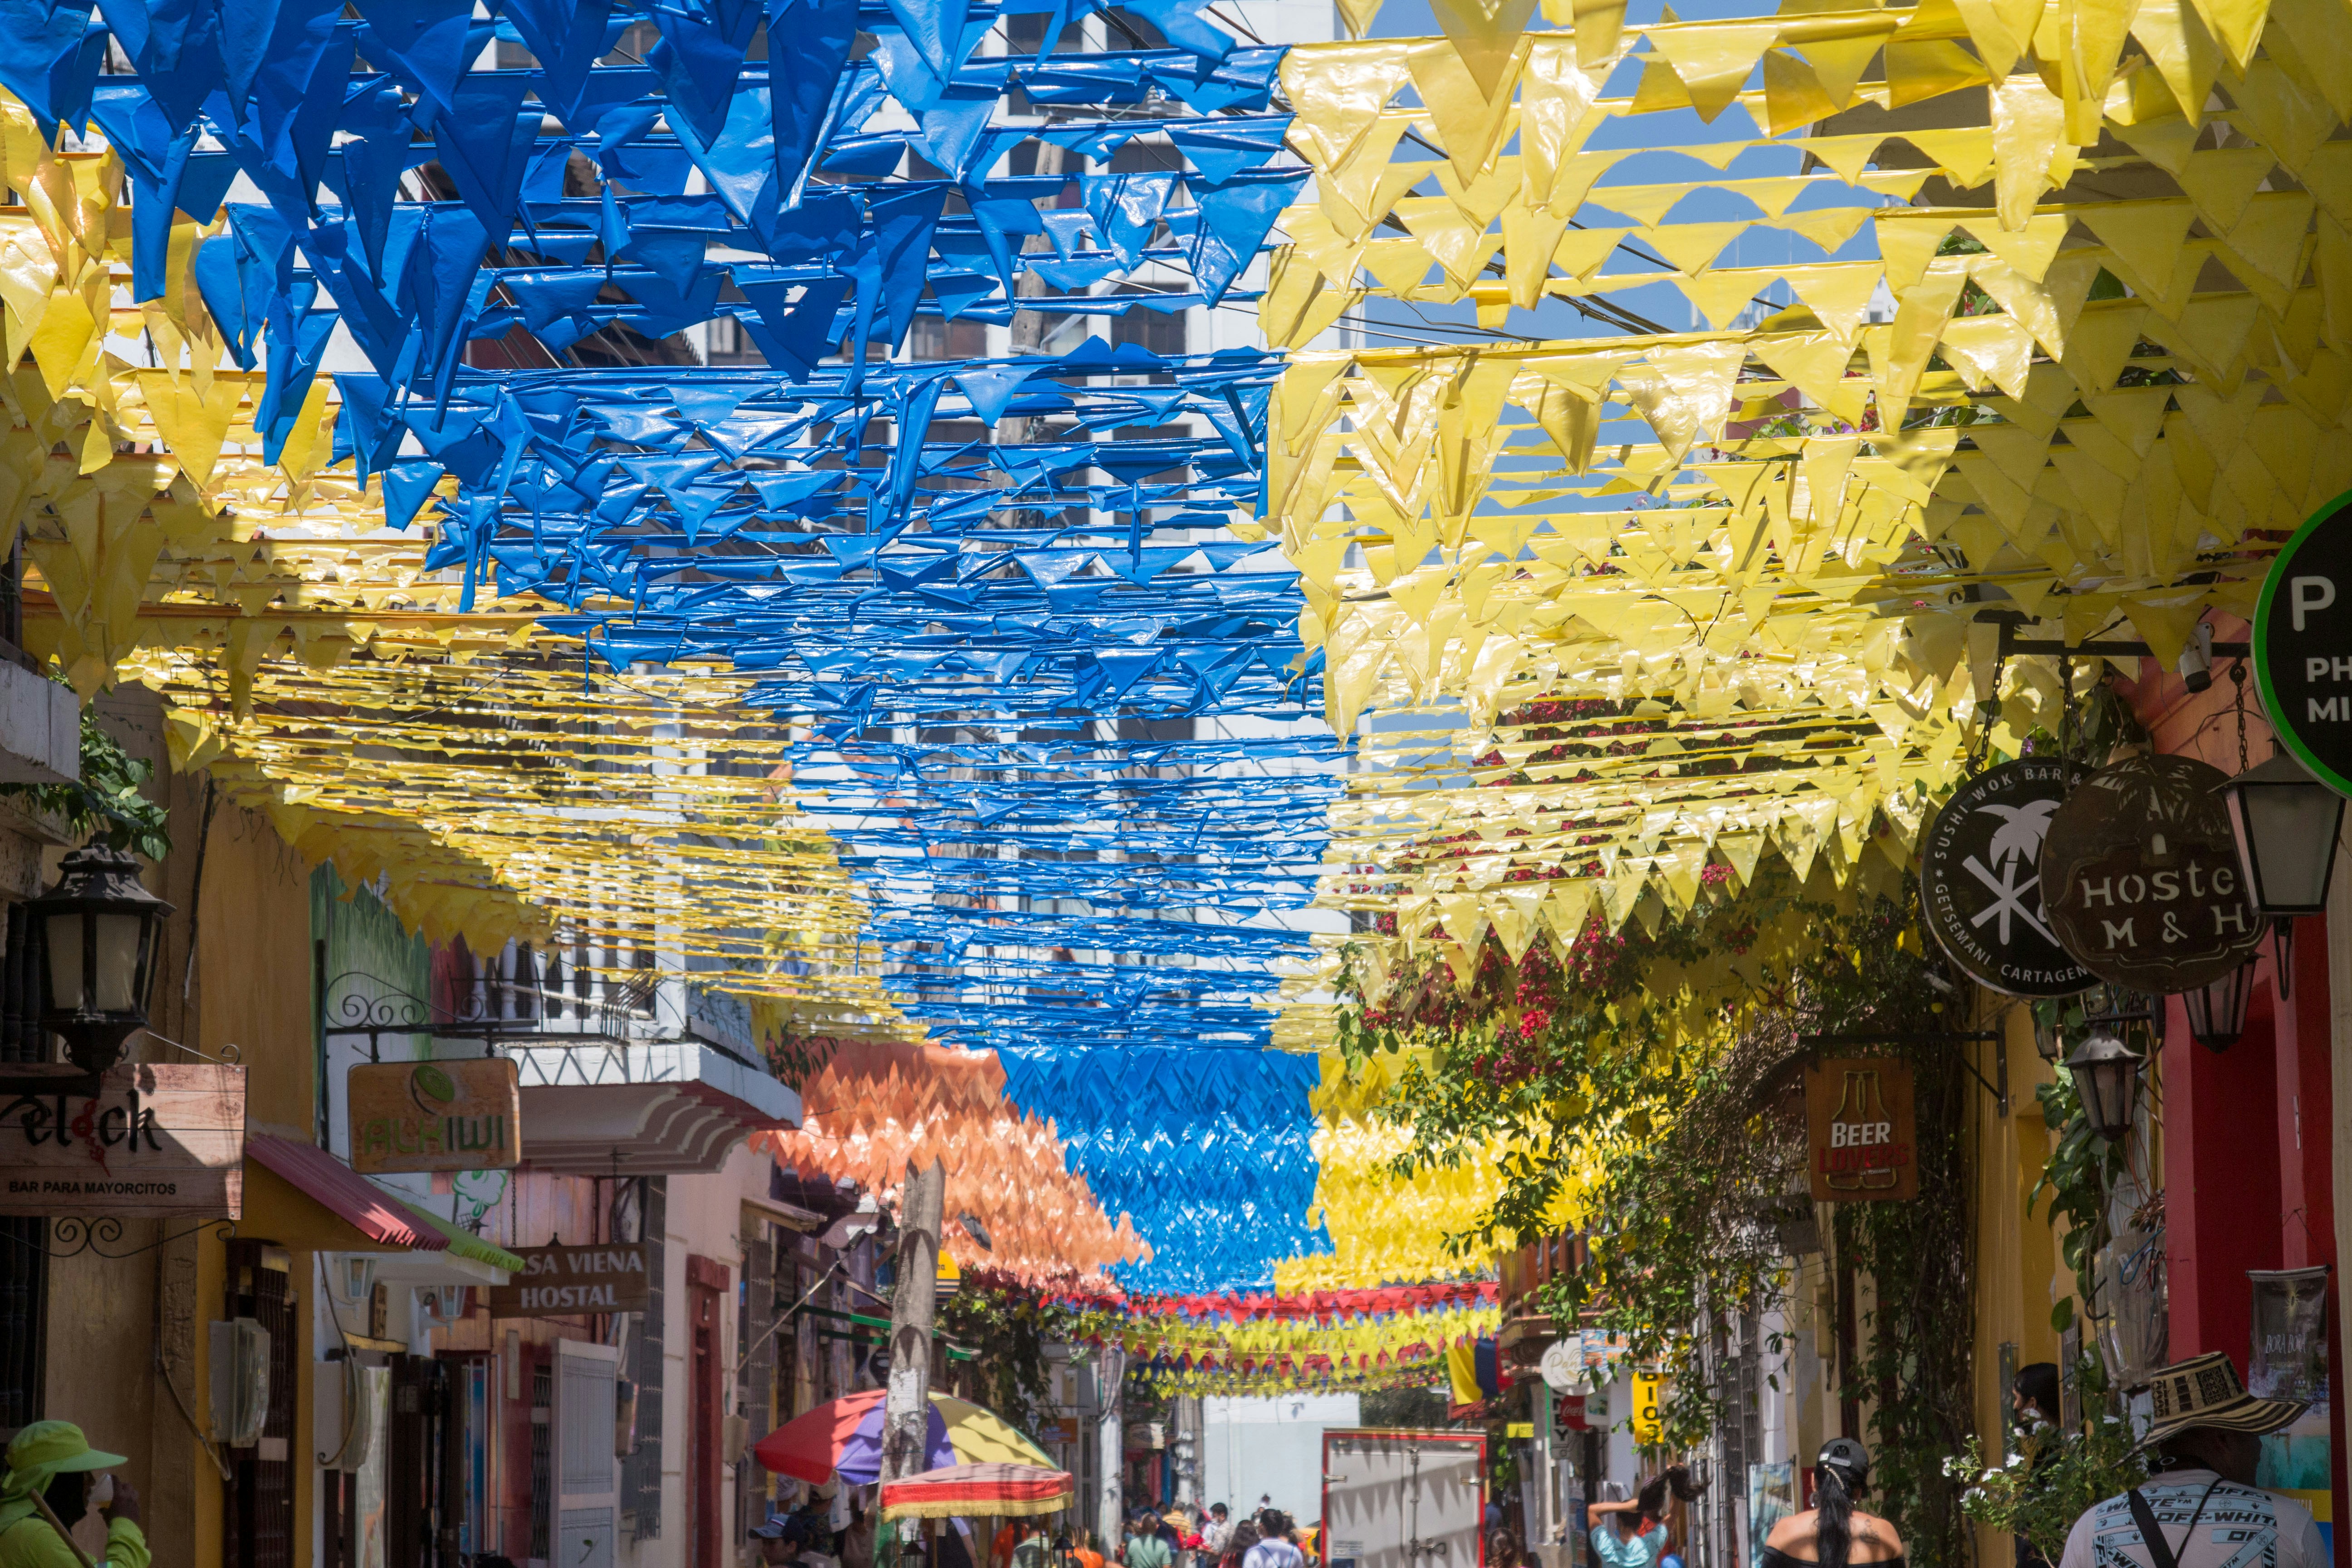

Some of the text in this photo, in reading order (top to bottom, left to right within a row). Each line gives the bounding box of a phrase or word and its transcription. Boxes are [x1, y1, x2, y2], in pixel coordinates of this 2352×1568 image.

[2291, 575, 2336, 632] P
[2307, 657, 2352, 682] PH
[1935, 768, 2081, 860] SUSHI WOK BAR &
[1935, 883, 2088, 983] GETSEMANI CARTAGEN
[2101, 903, 2247, 949] M & H
[364, 1115, 504, 1154] ALKIWI
[1831, 1122, 1891, 1148] BEER
[1818, 1143, 1908, 1173] LOVERS
[9, 1181, 176, 1196] BAR PARA MAYORCITOS
[567, 1250, 644, 1274] VIENA
[521, 1284, 620, 1308] HOSTAL
[2265, 1333, 2306, 1354] BORA BORA
